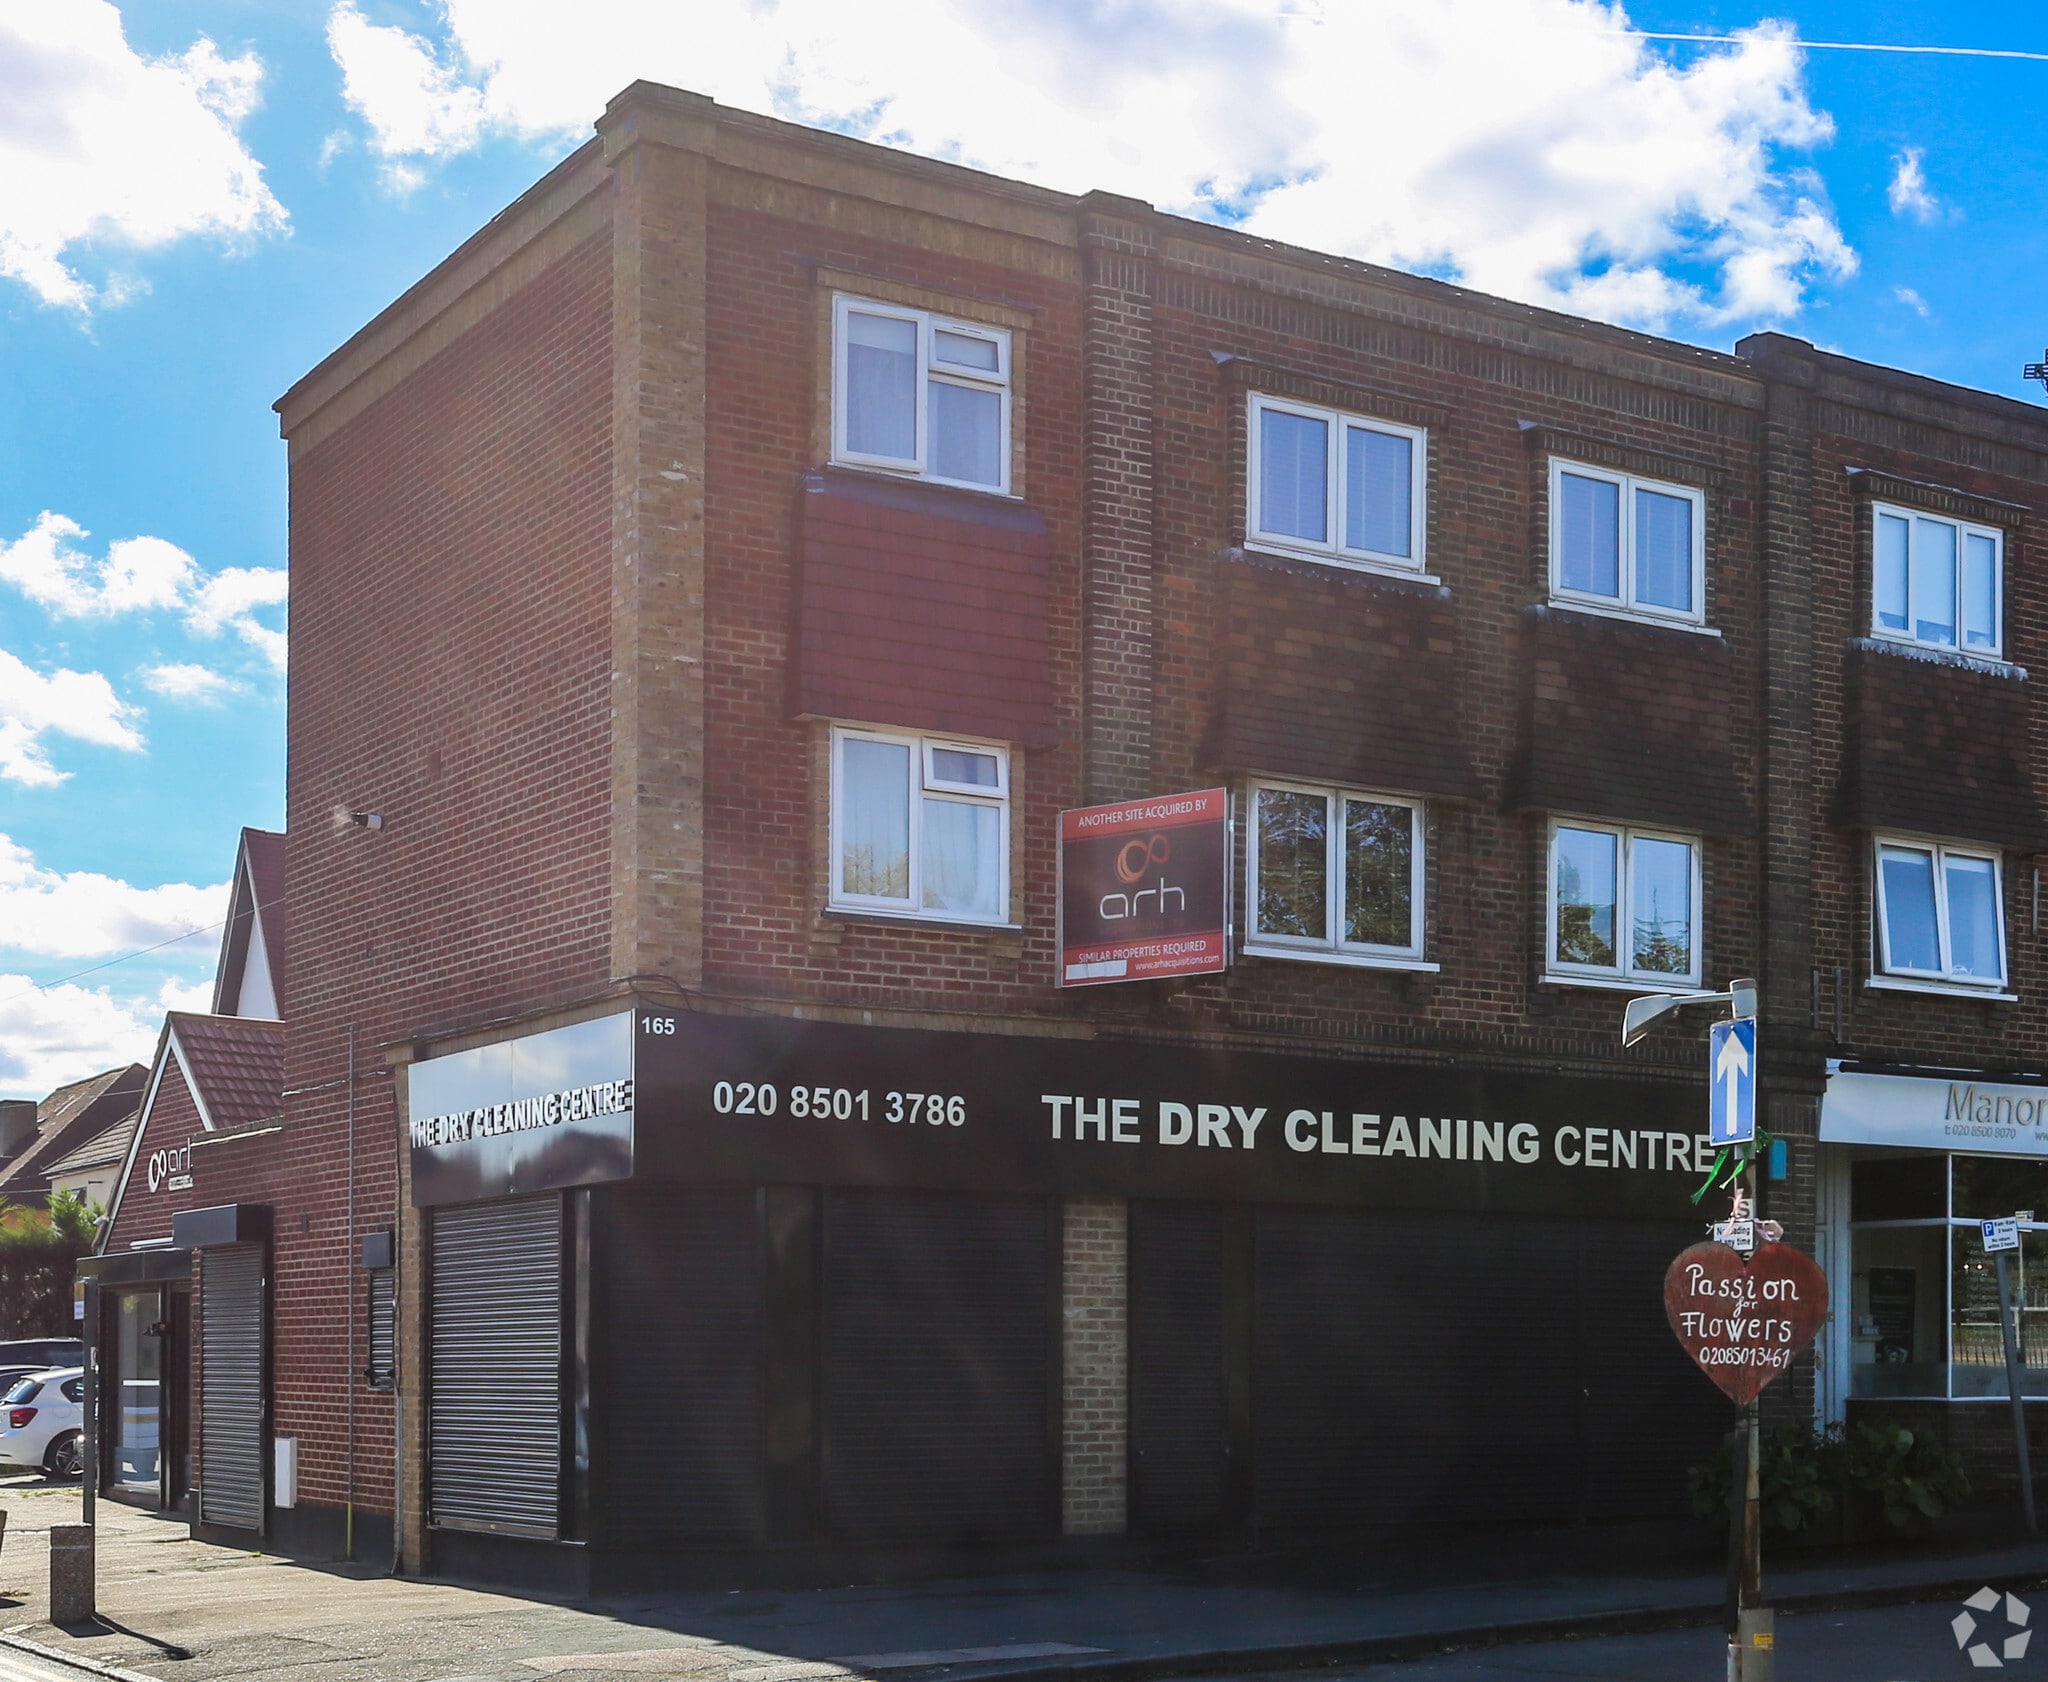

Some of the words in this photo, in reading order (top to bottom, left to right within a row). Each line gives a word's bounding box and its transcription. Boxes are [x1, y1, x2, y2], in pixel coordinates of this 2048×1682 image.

[1078, 810, 1123, 828] ANOTHER
[1125, 808, 1143, 822] SITE
[1145, 801, 1193, 819] ACQUIRED
[1195, 799, 1208, 811] BY
[1100, 877, 1185, 920] arh
[1078, 949, 1111, 964] SIMILAR
[1113, 945, 1161, 960] PROPERTIES
[1163, 940, 1206, 956] REQUIRED
[1135, 955, 1220, 970] www.arhacquisitions.com
[641, 1016, 676, 1036] 165
[410, 1117, 436, 1149] THE
[438, 1111, 470, 1144] DRY
[471, 1094, 556, 1137] CLEANING
[560, 1079, 626, 1121] CENTRE
[712, 1081, 778, 1116] 020
[790, 1085, 870, 1121] 8501
[884, 1091, 967, 1127] 3786
[1945, 1083, 2048, 1126] Manor
[1041, 1094, 1141, 1144] THE
[1157, 1102, 1268, 1150] DRY
[1283, 1109, 1541, 1164] CLEANING
[1554, 1124, 1716, 1173] CENTRE
[1952, 1124, 1970, 1136] 020
[1971, 1126, 1993, 1138] 8500
[1994, 1127, 2017, 1140] 8070
[1685, 1264, 1799, 1300] Passion
[1733, 1296, 1758, 1318] for
[1680, 1311, 1791, 1343] Flowers
